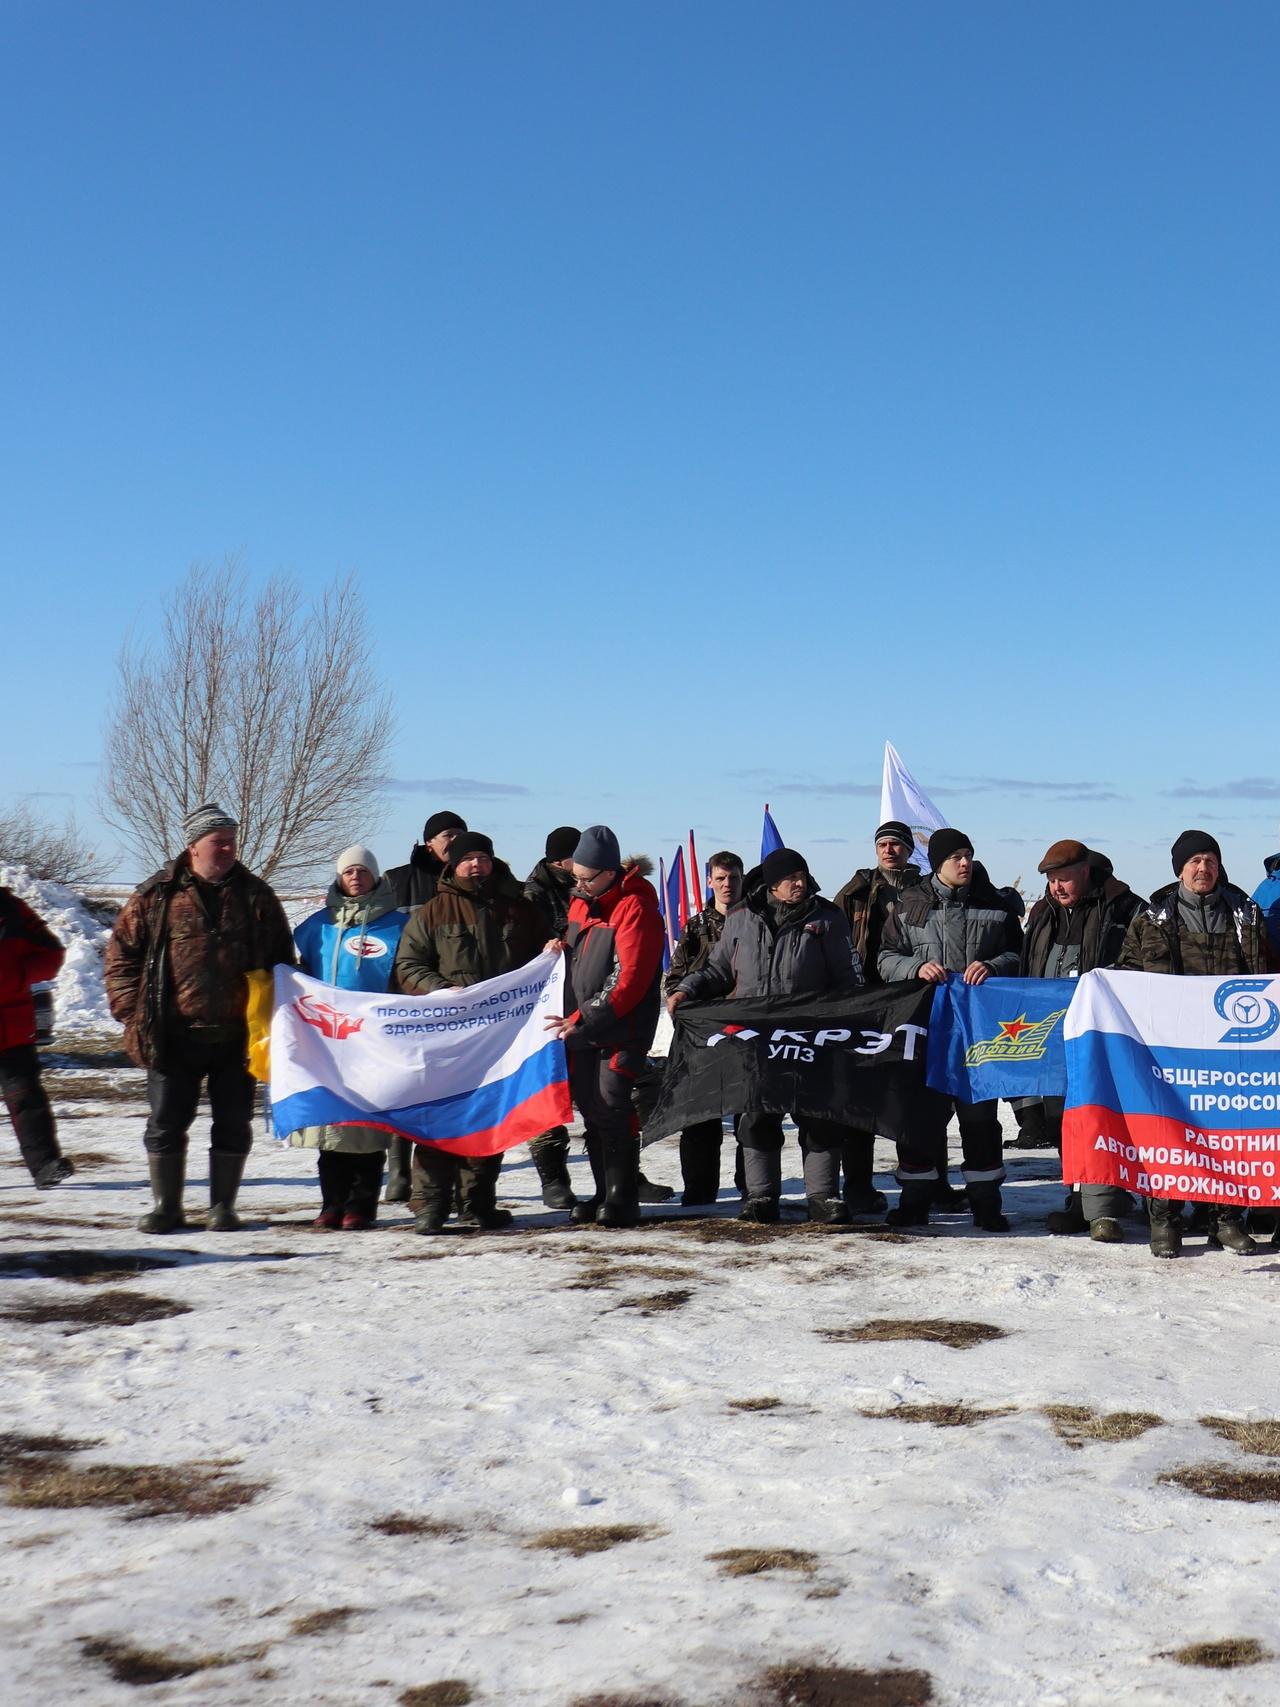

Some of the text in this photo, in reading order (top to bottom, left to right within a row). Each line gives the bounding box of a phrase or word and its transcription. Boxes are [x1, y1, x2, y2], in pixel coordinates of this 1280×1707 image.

[384, 1002, 534, 1036] ЗДРАВООХРАНЕНИЯ
[768, 1044, 815, 1063] УПЗ
[770, 1023, 928, 1061] КРЭТ
[1094, 1135, 1275, 1177] АВТОМОБИЛЬНОГО
[1119, 1164, 1130, 1183] И
[1136, 1172, 1261, 1201] ДОРОЖНОГО
